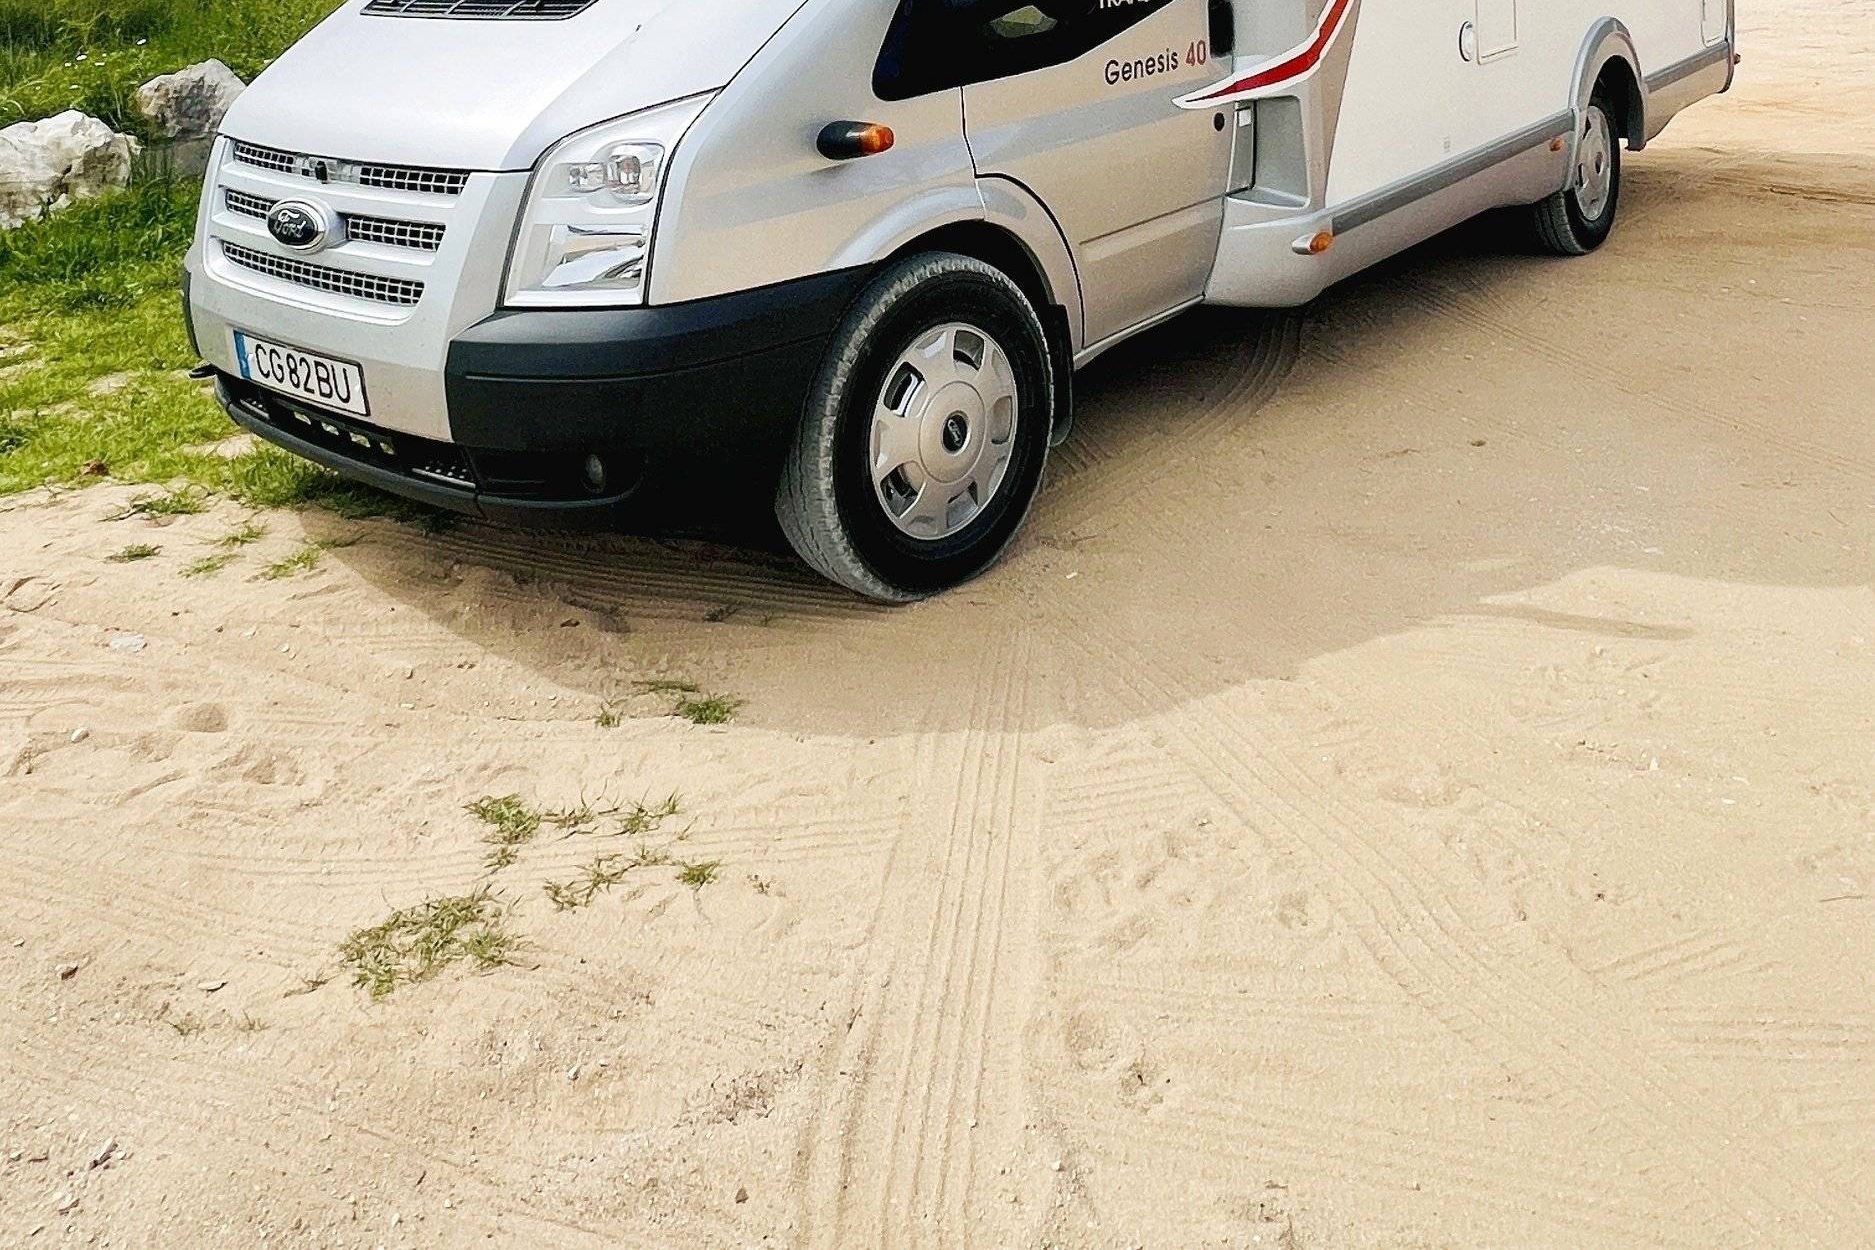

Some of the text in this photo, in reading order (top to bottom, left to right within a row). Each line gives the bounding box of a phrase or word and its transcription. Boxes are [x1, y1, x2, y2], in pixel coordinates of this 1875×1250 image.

[1104, 39, 1207, 86] Genesis 40
[274, 209, 307, 238] Ford
[255, 343, 351, 404] CG82BU
